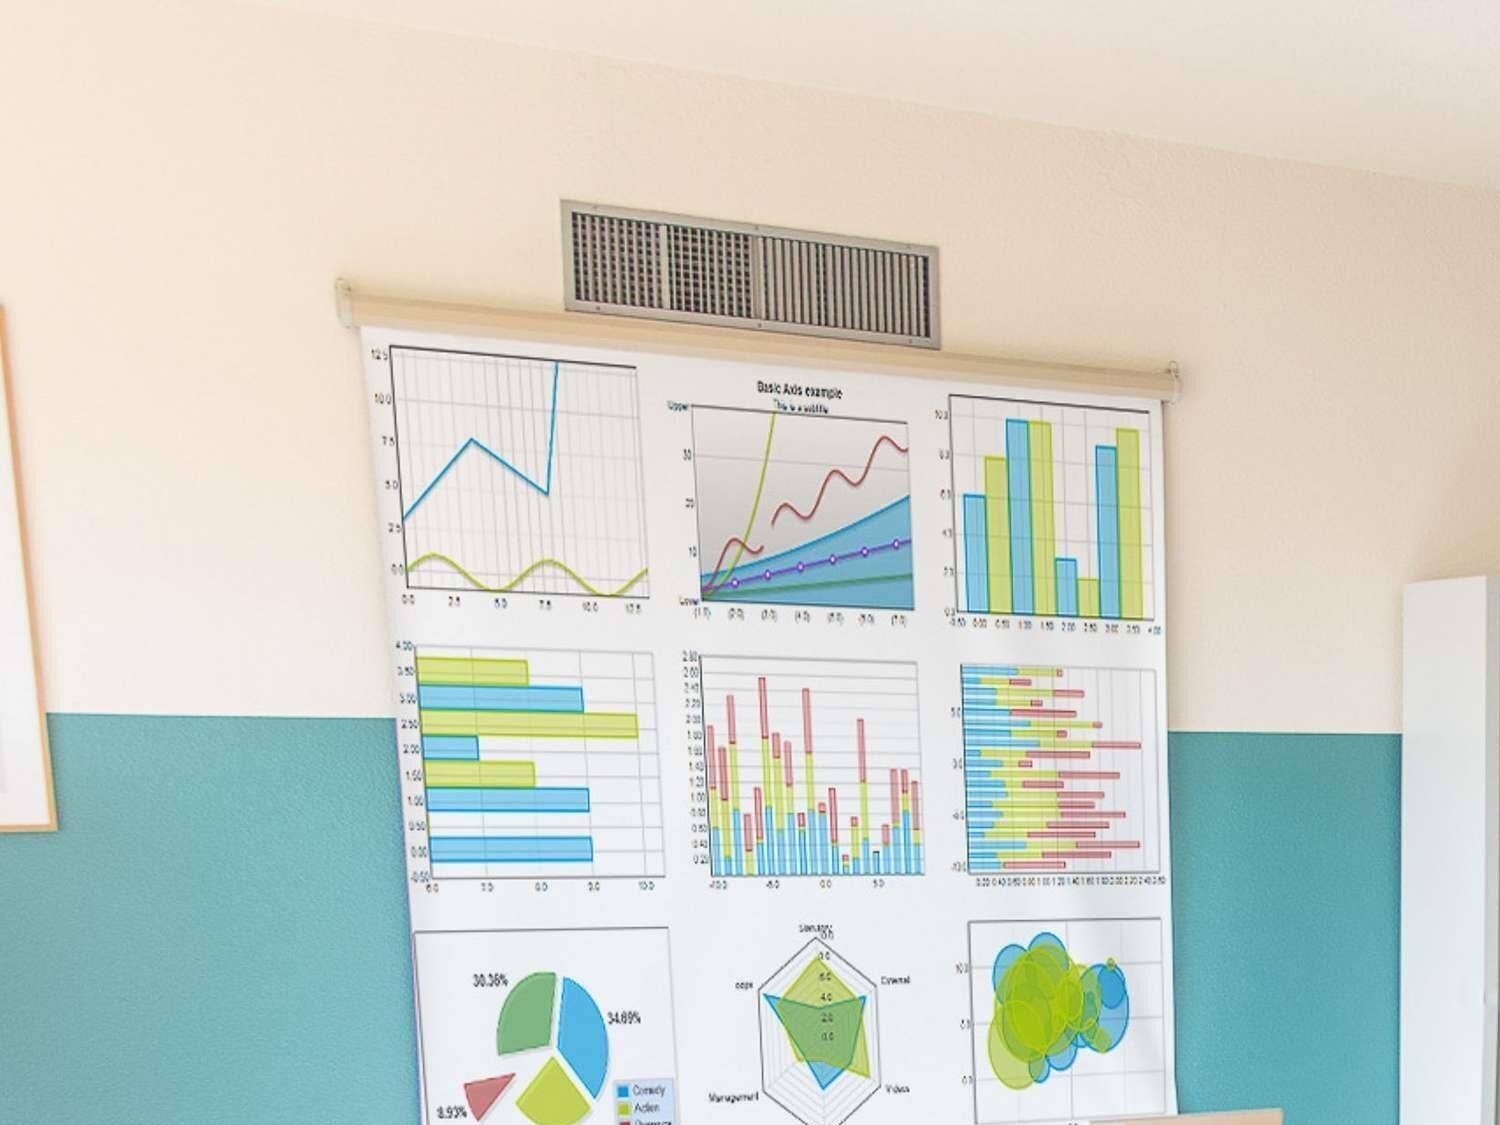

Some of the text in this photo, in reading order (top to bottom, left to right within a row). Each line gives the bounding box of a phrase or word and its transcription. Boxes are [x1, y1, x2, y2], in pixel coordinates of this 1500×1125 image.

[757, 380, 843, 400] Basic Axis example
[633, 1084, 665, 1097] Comedy
[635, 1103, 660, 1113] Action
